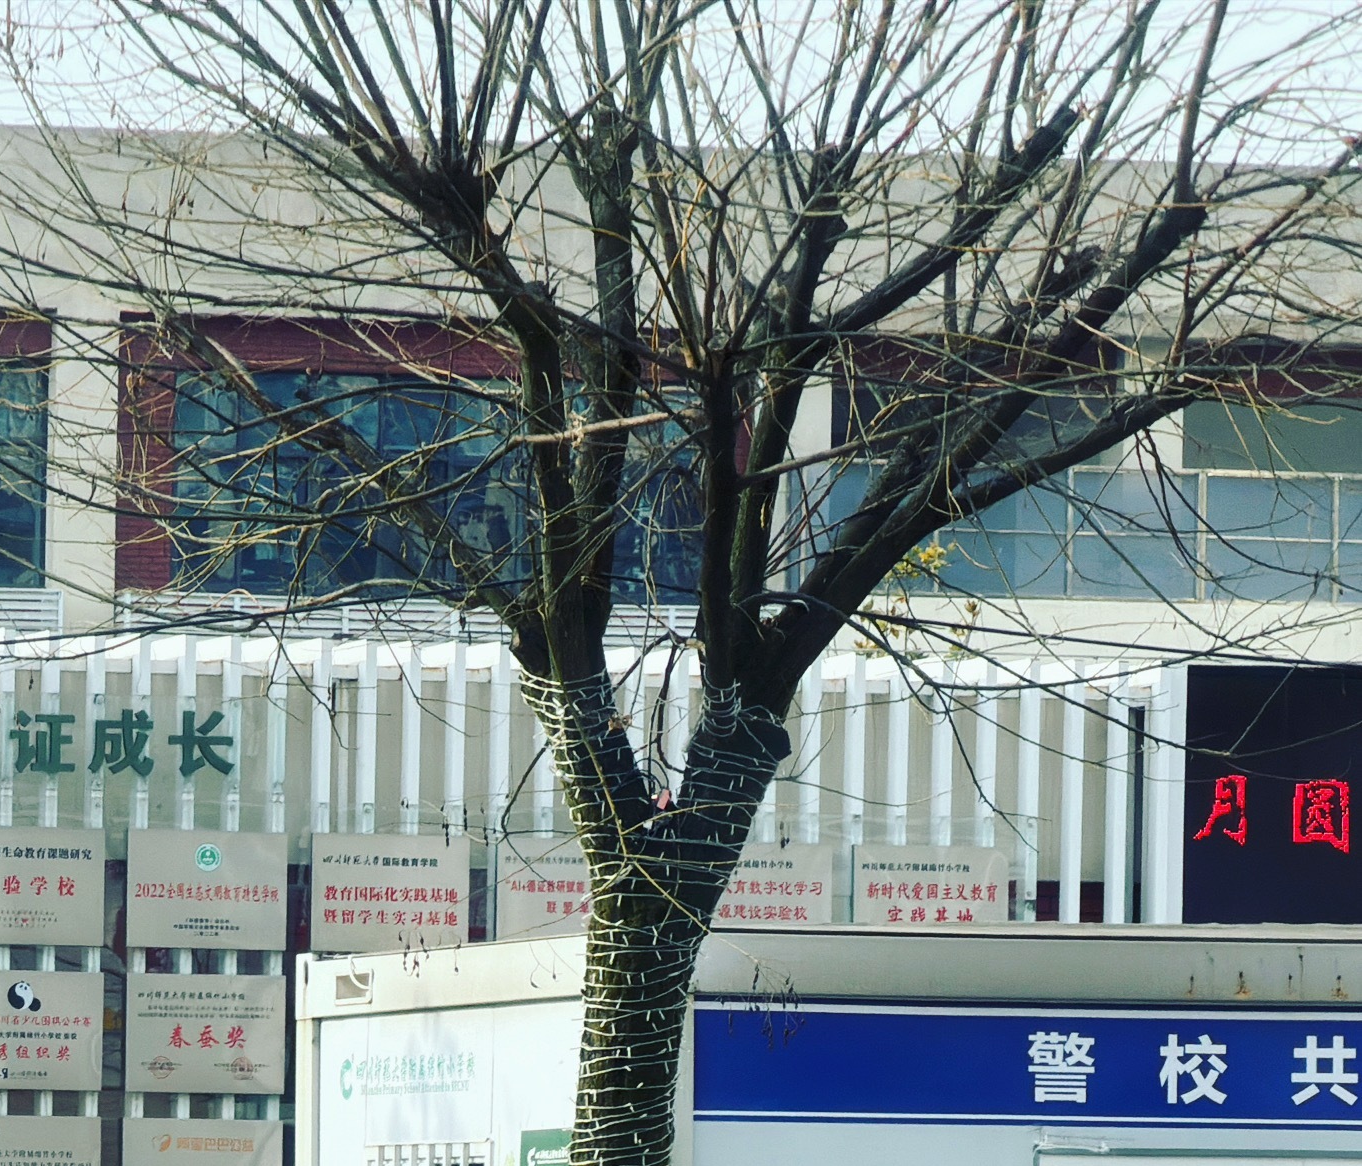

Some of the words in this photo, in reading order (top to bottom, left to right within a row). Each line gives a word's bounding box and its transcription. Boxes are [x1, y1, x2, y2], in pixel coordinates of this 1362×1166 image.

[1192, 774, 1350, 854] 月圆
[323, 885, 459, 904] 教育国际化实践基地
[866, 881, 998, 903] 新时代爱国主义教育
[323, 908, 459, 927] 暨留学生实习基地
[887, 905, 975, 923] 实践基地
[167, 1024, 247, 1049] 春蚕奖
[1027, 1031, 1360, 1106] 警校共
